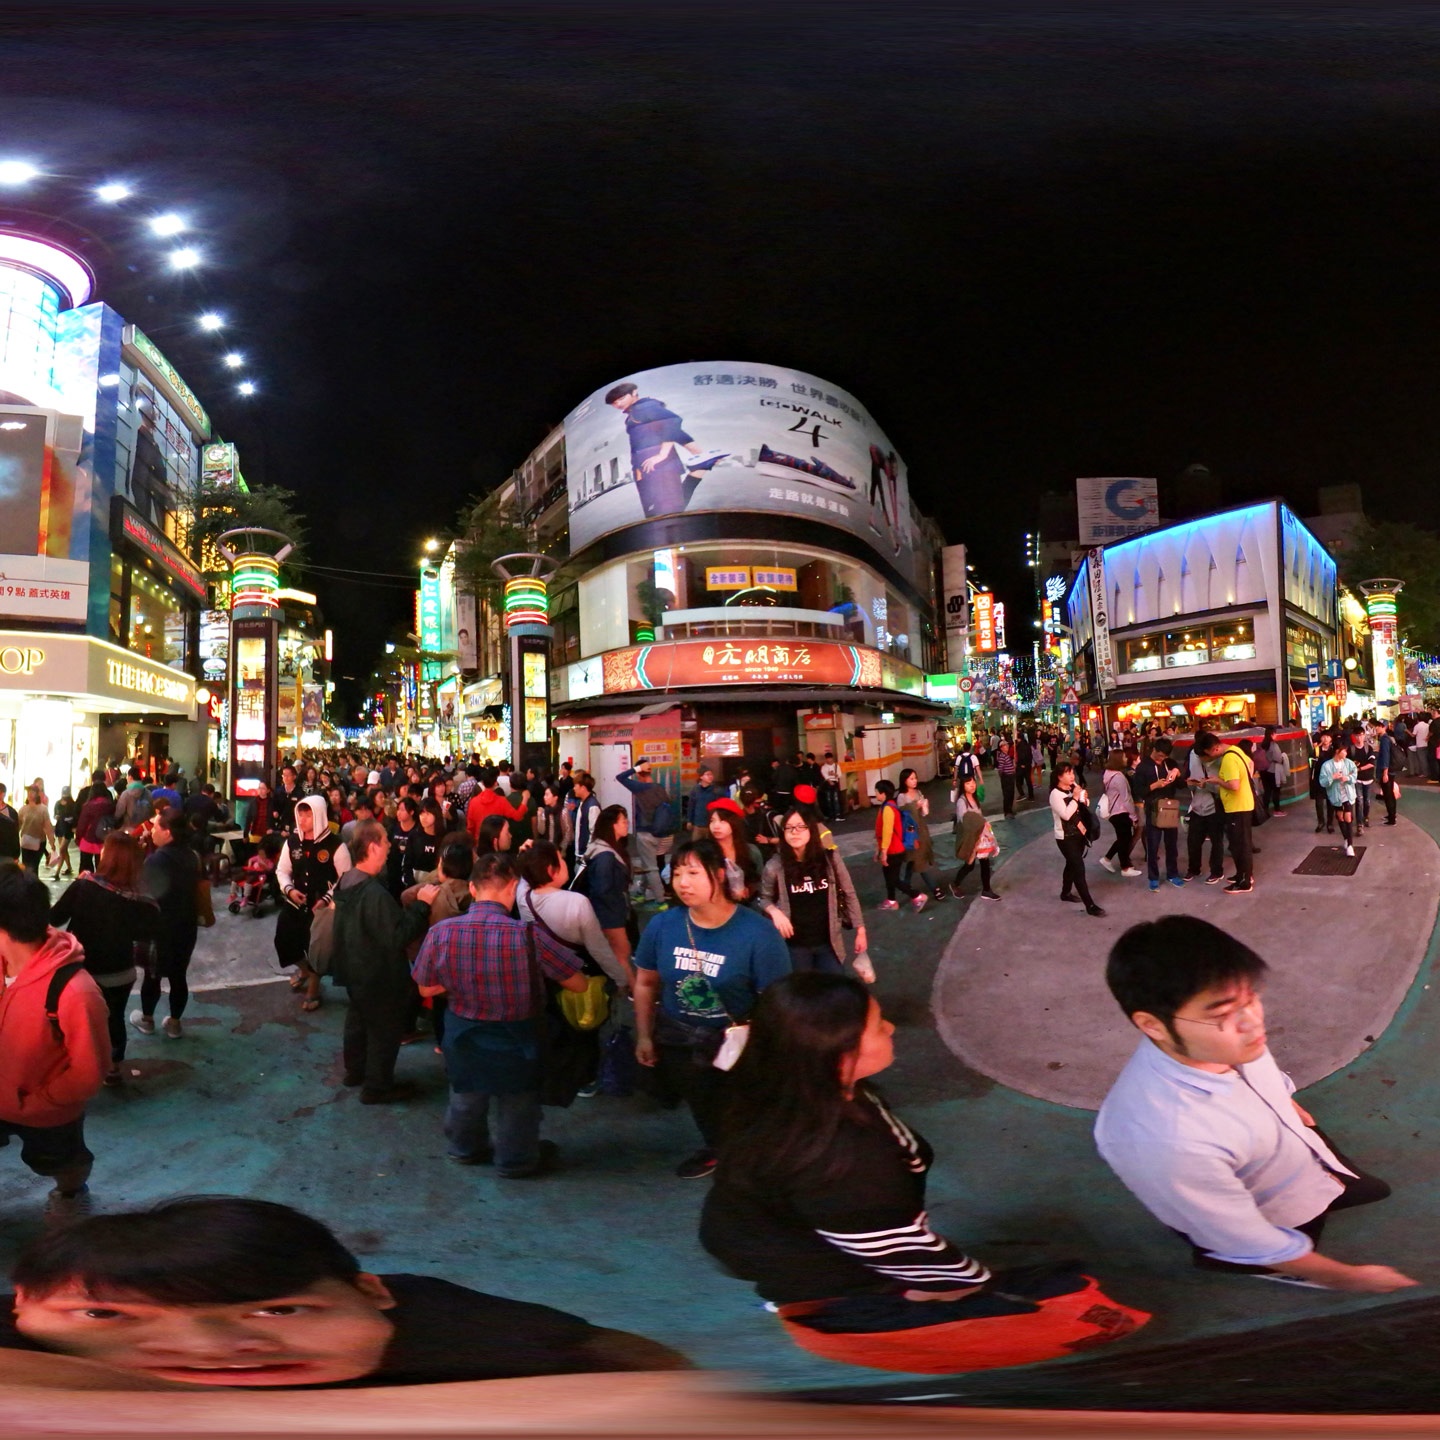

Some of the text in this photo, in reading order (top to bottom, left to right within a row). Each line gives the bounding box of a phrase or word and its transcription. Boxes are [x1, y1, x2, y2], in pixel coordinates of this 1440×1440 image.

[693, 374, 778, 389] 舒適決勝
[768, 487, 849, 517] 走路就是運動
